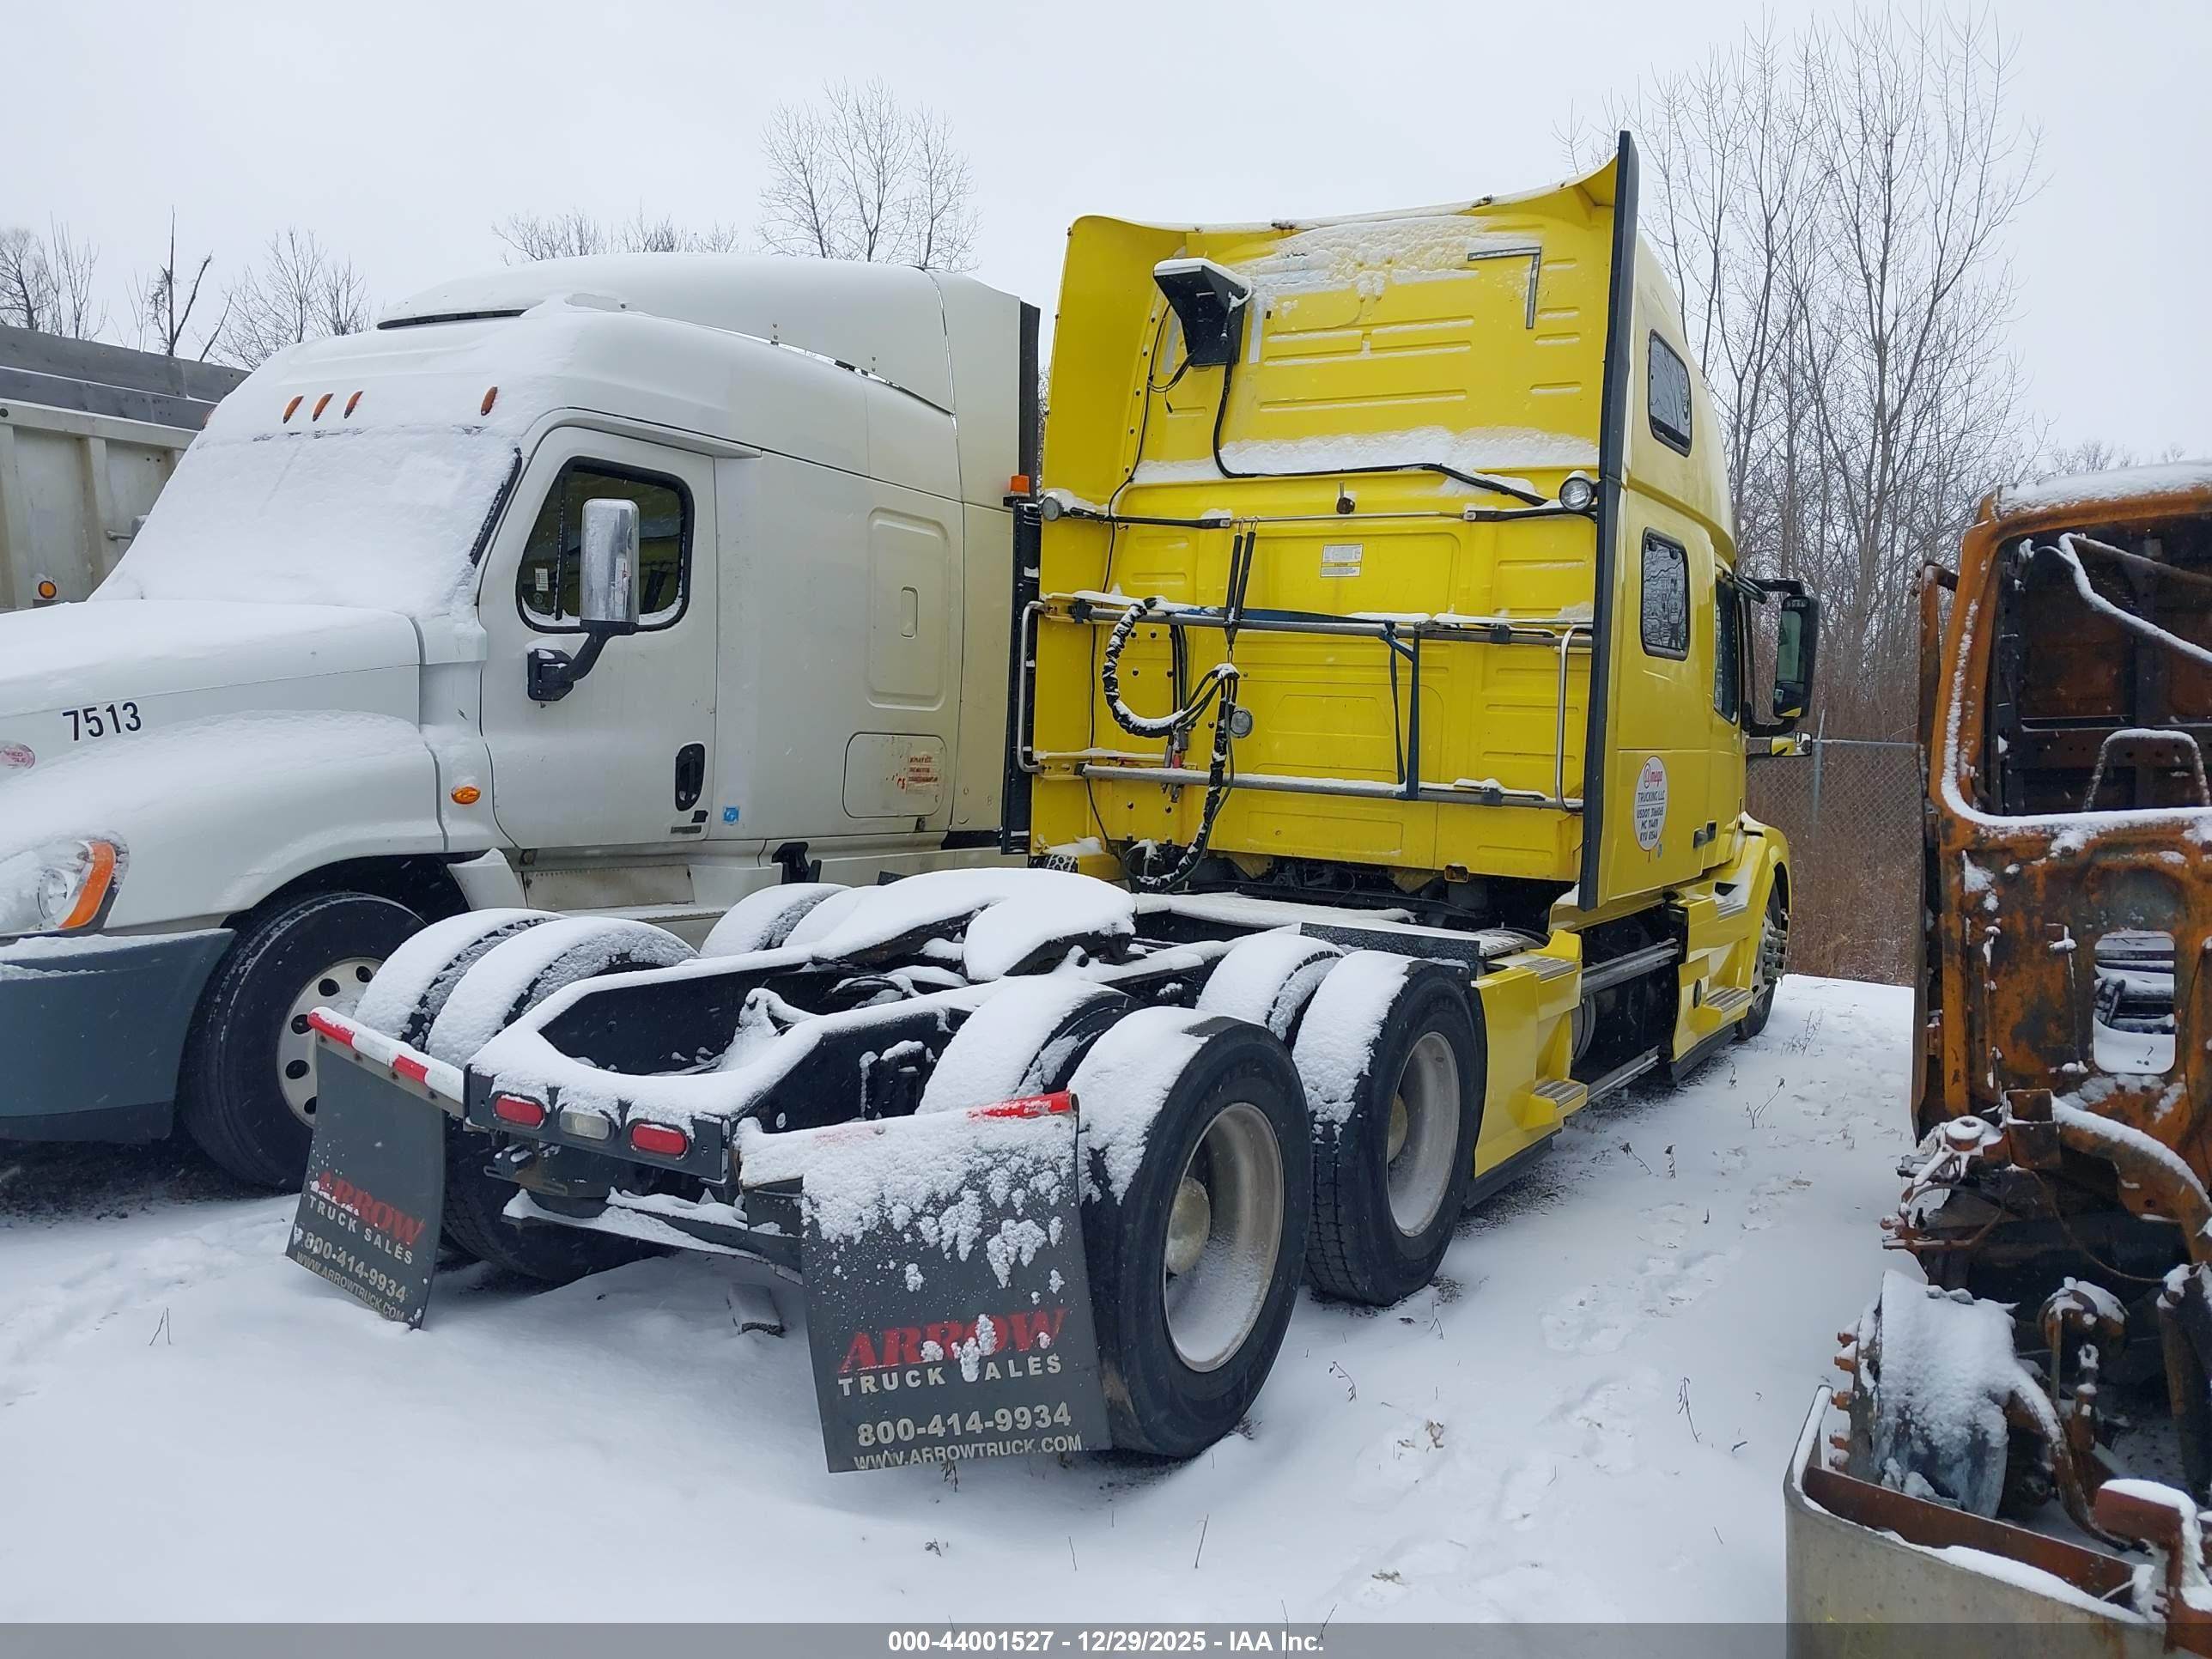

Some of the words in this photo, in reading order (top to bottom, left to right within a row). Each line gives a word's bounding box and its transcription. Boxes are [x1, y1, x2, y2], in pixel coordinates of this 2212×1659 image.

[62, 702, 142, 741] 7513
[308, 1195, 357, 1233] TRUCK
[363, 1227, 413, 1264] SALES
[310, 1170, 426, 1248] ARROW
[296, 1251, 405, 1322] WWW.ARROWTRUCK.COM
[304, 1232, 406, 1303] 800-414-9934
[838, 1308, 1068, 1372] ARROW
[837, 1366, 946, 1396] TRUCK
[963, 1353, 1062, 1383] ALES
[854, 1434, 1082, 1470] WWW.ARROWTRUCK.COM
[857, 1402, 1072, 1446] 800-414-9934
